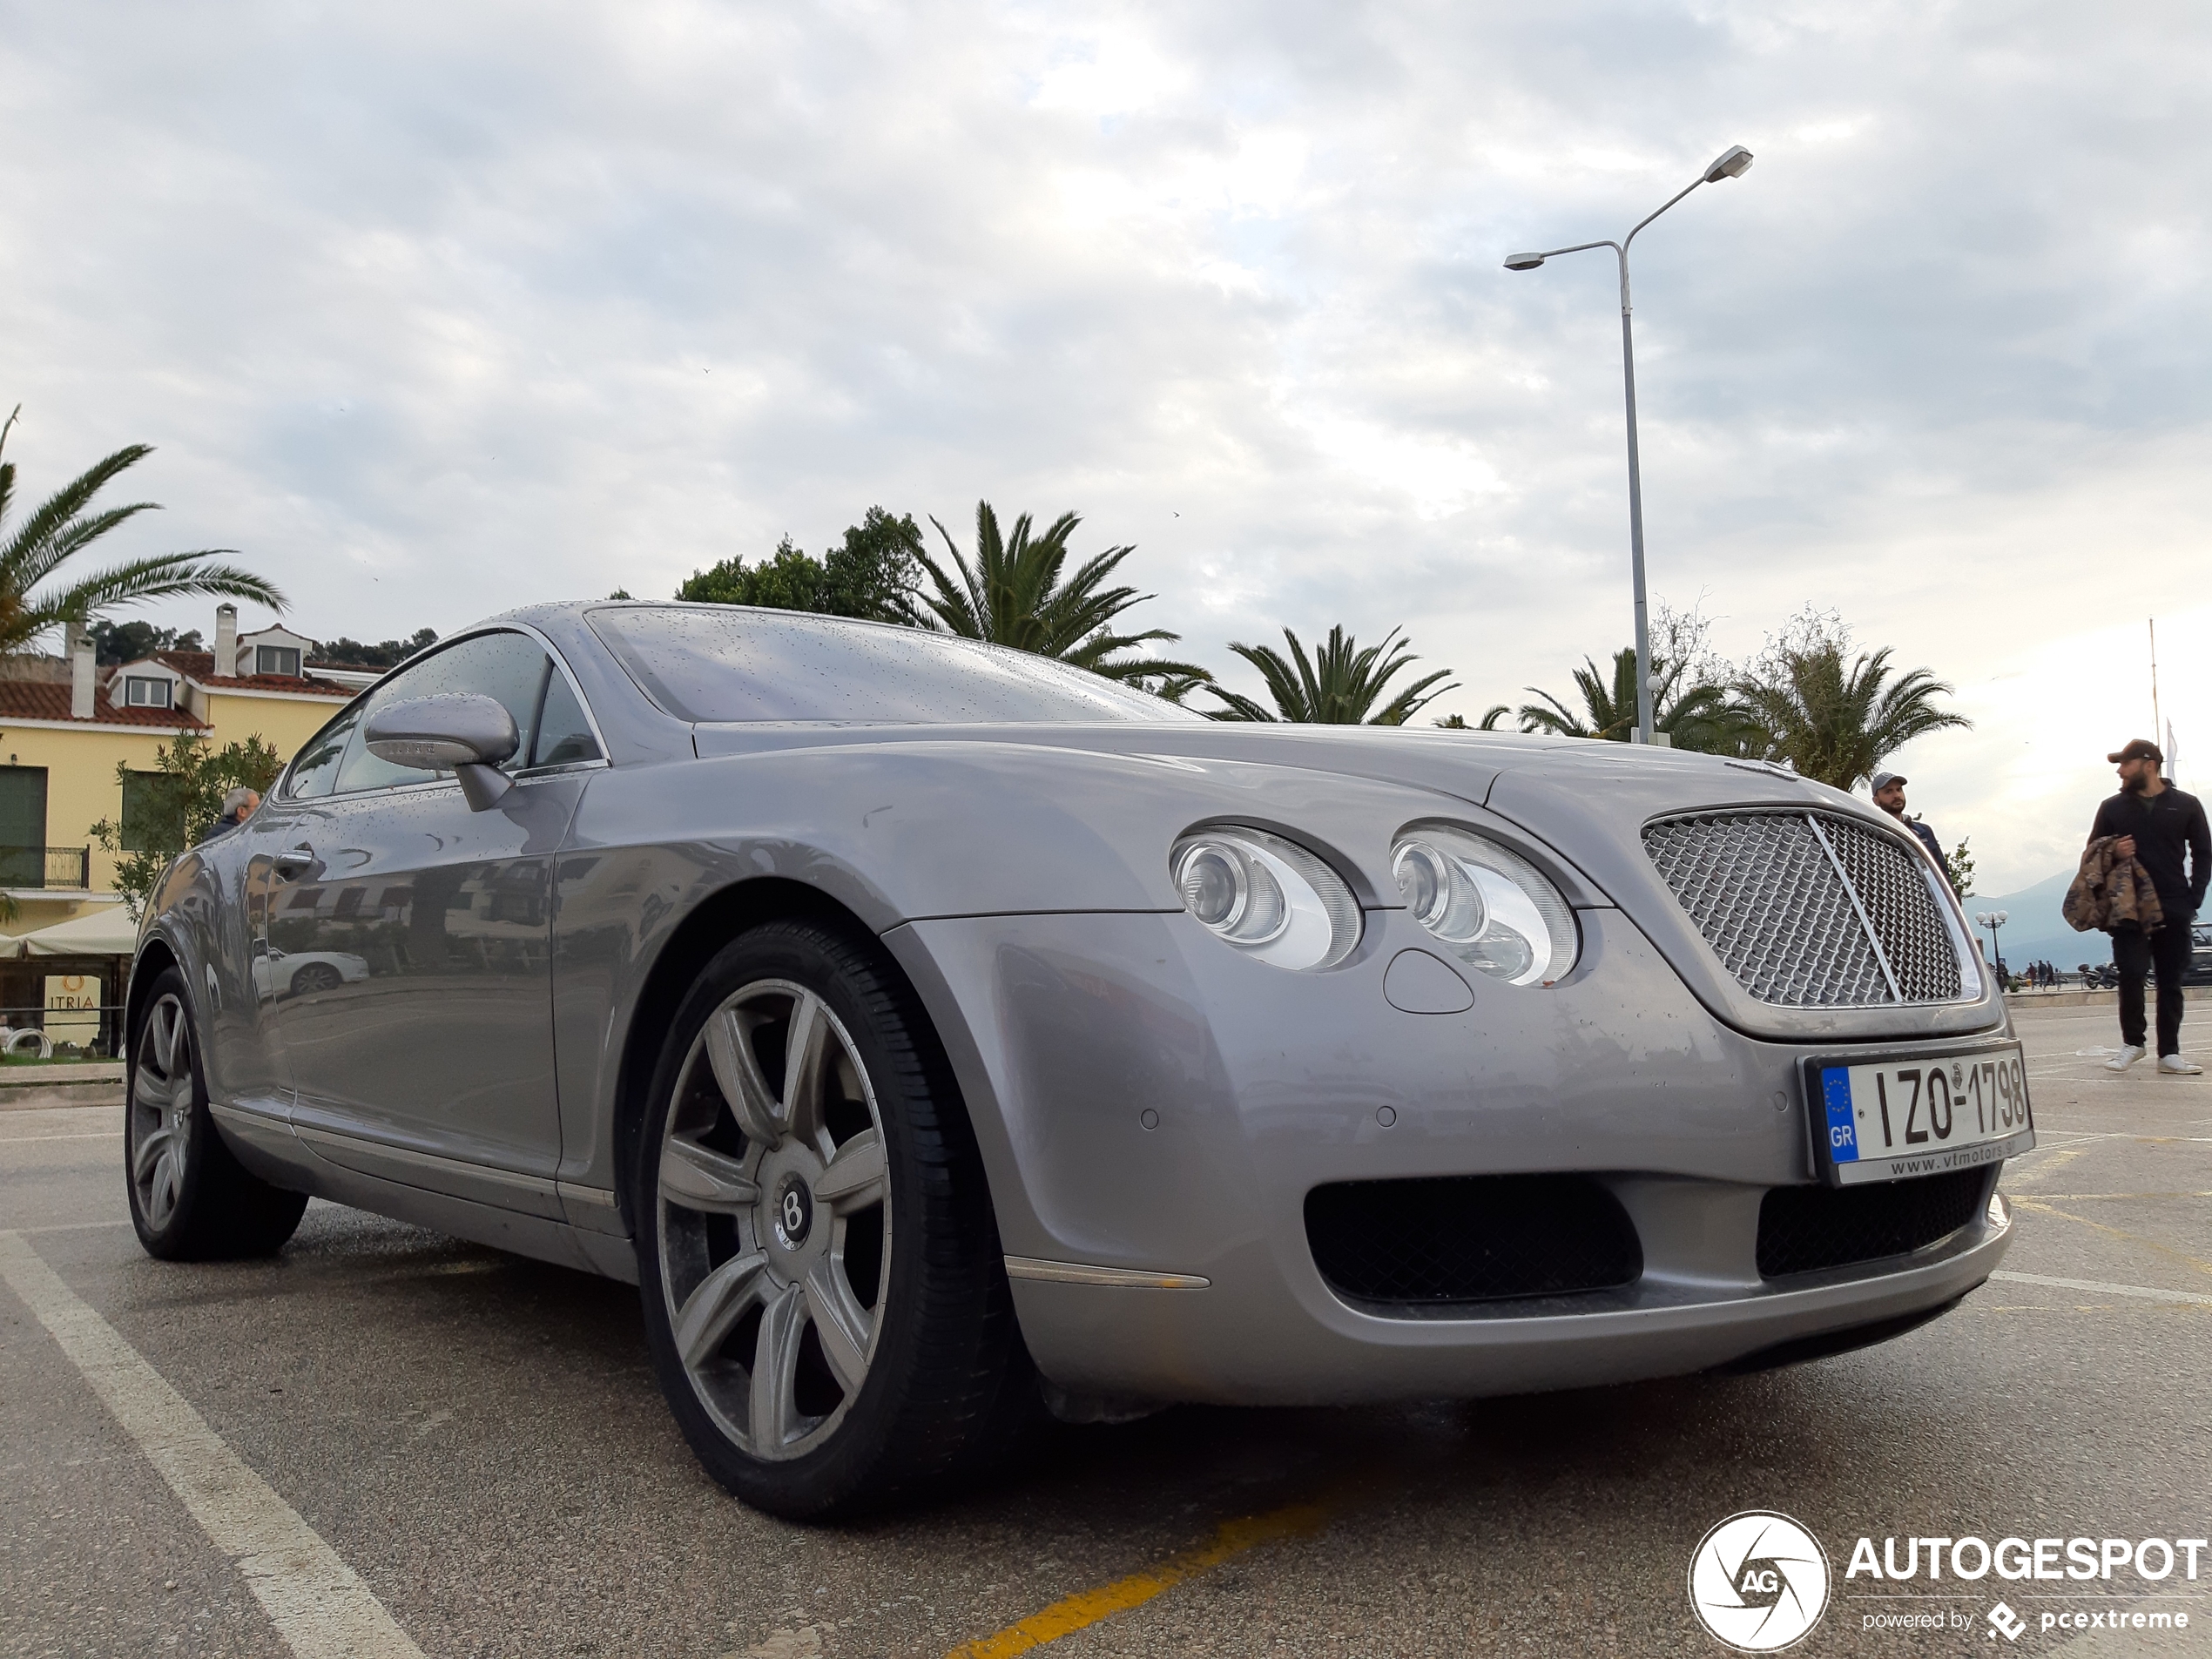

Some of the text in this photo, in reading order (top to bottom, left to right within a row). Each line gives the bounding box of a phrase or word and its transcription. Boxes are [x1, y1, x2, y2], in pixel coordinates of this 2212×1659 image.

[51, 995, 94, 1009] ITRIA
[1876, 1056, 2025, 1148] IZO-1798
[1830, 1125, 1854, 1148] GR
[1891, 1138, 2017, 1176] www.vtmotors.gr
